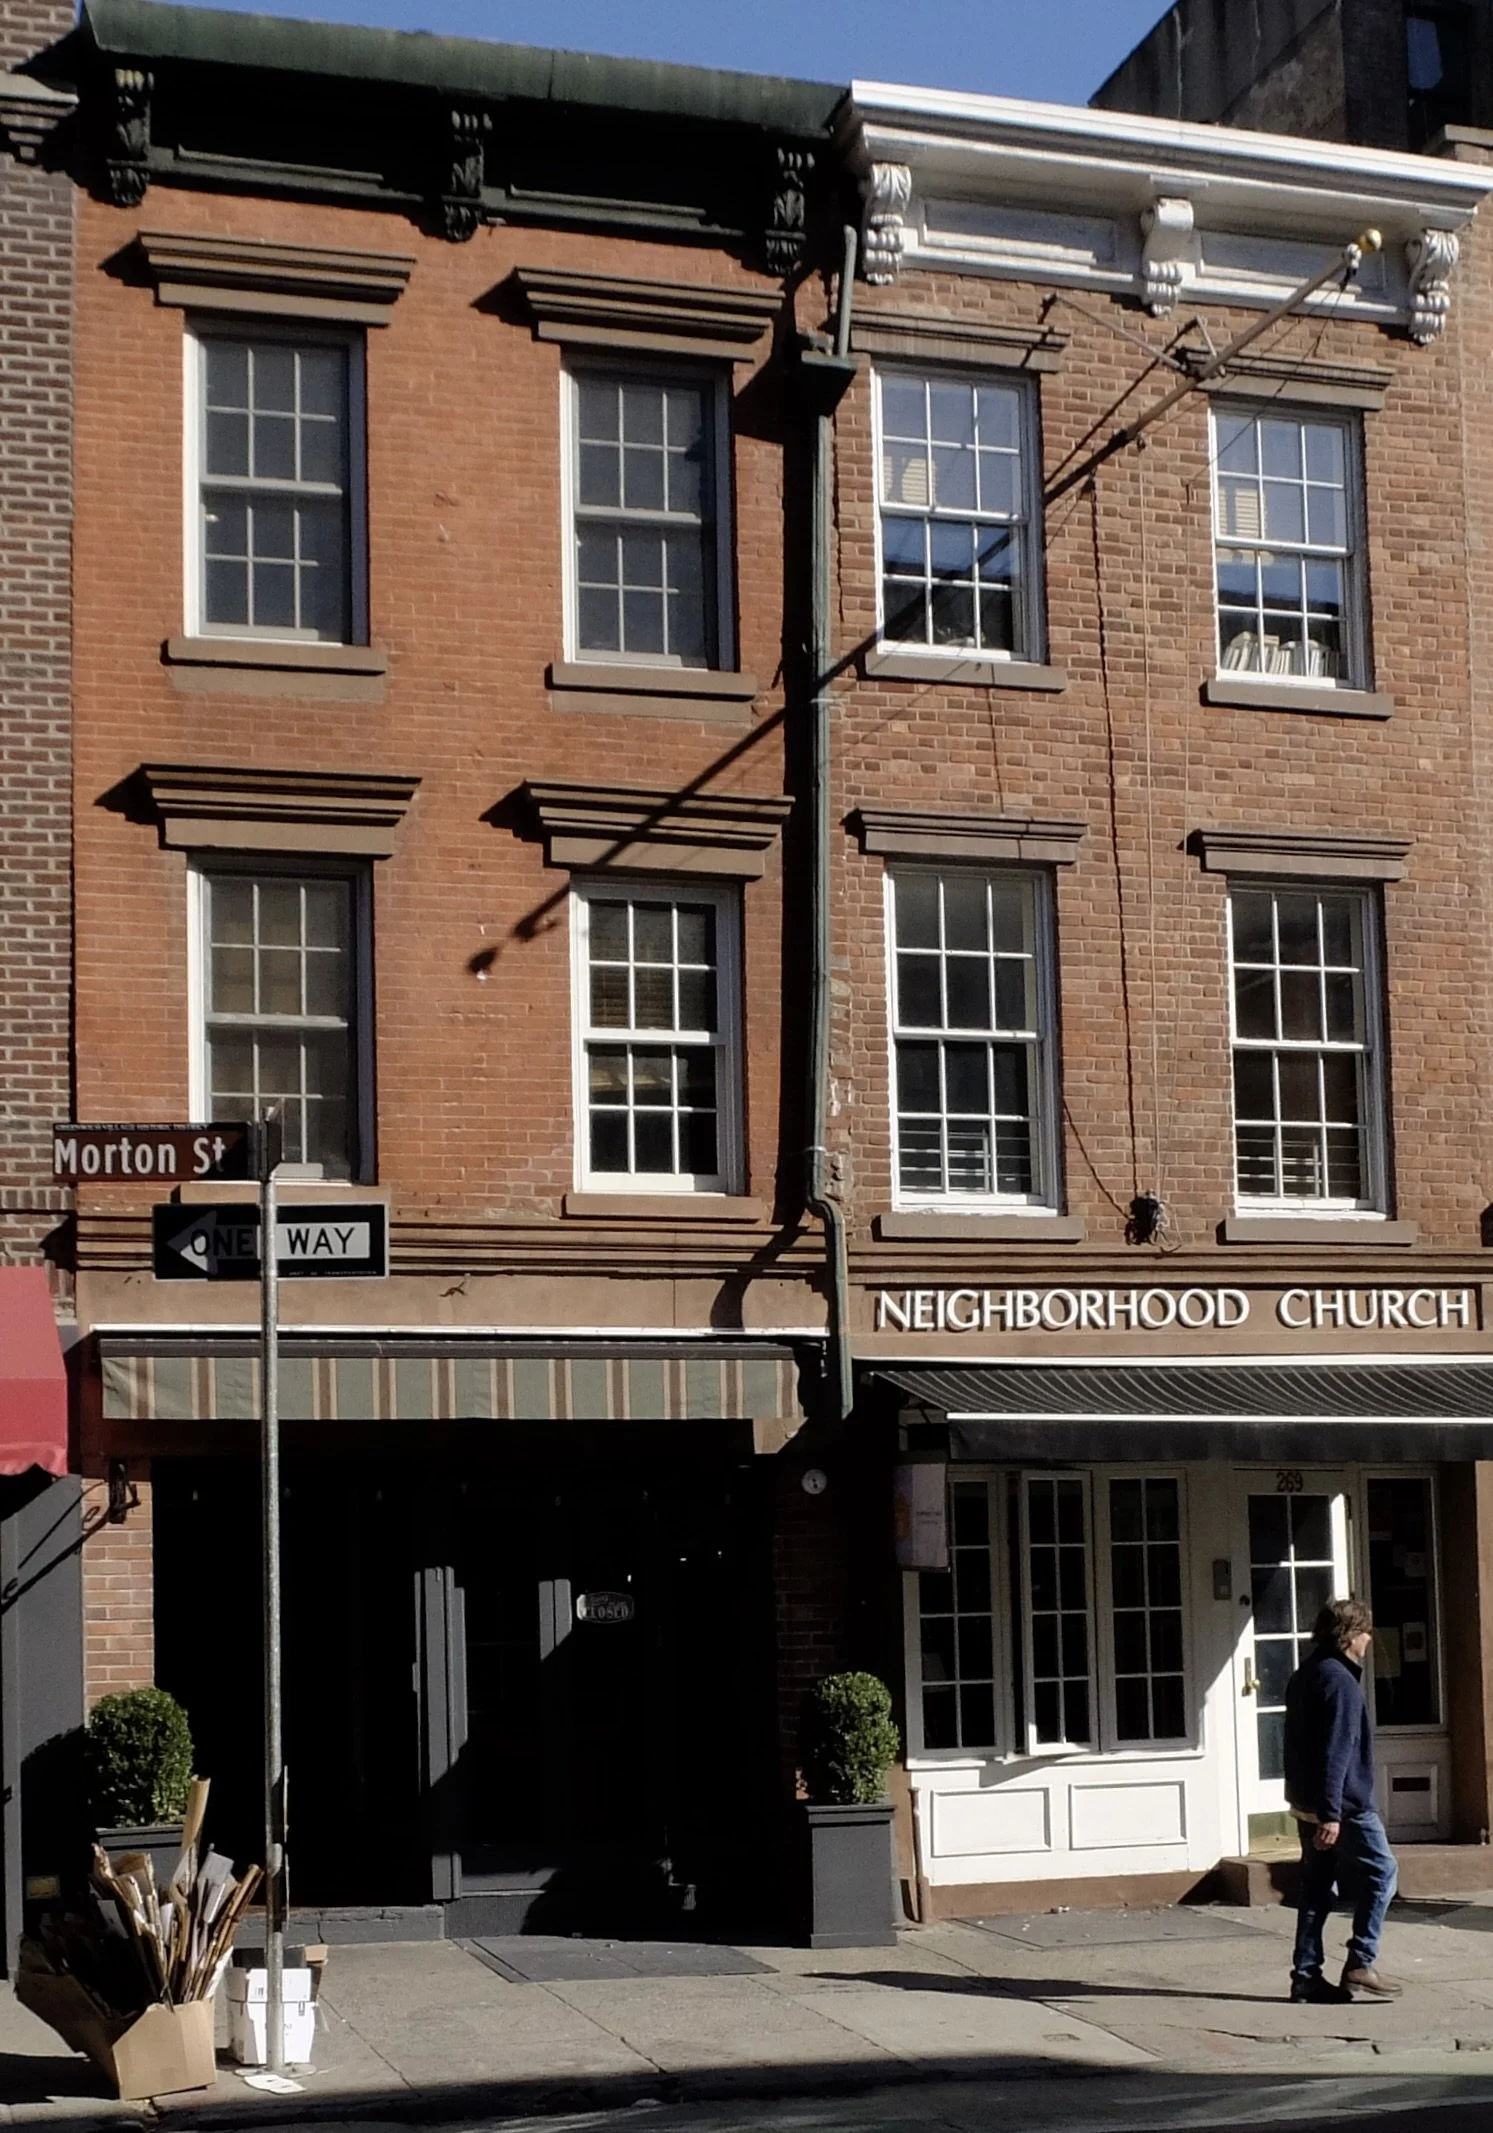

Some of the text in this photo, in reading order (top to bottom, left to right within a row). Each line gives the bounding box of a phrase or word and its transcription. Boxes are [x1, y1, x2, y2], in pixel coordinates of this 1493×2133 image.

[54, 1136, 226, 1174] Morton St
[191, 1227, 355, 1256] ONE WAY
[879, 1288, 1469, 1329] NEIGHBORHOOD CHURCH
[1276, 1471, 1303, 1492] 269
